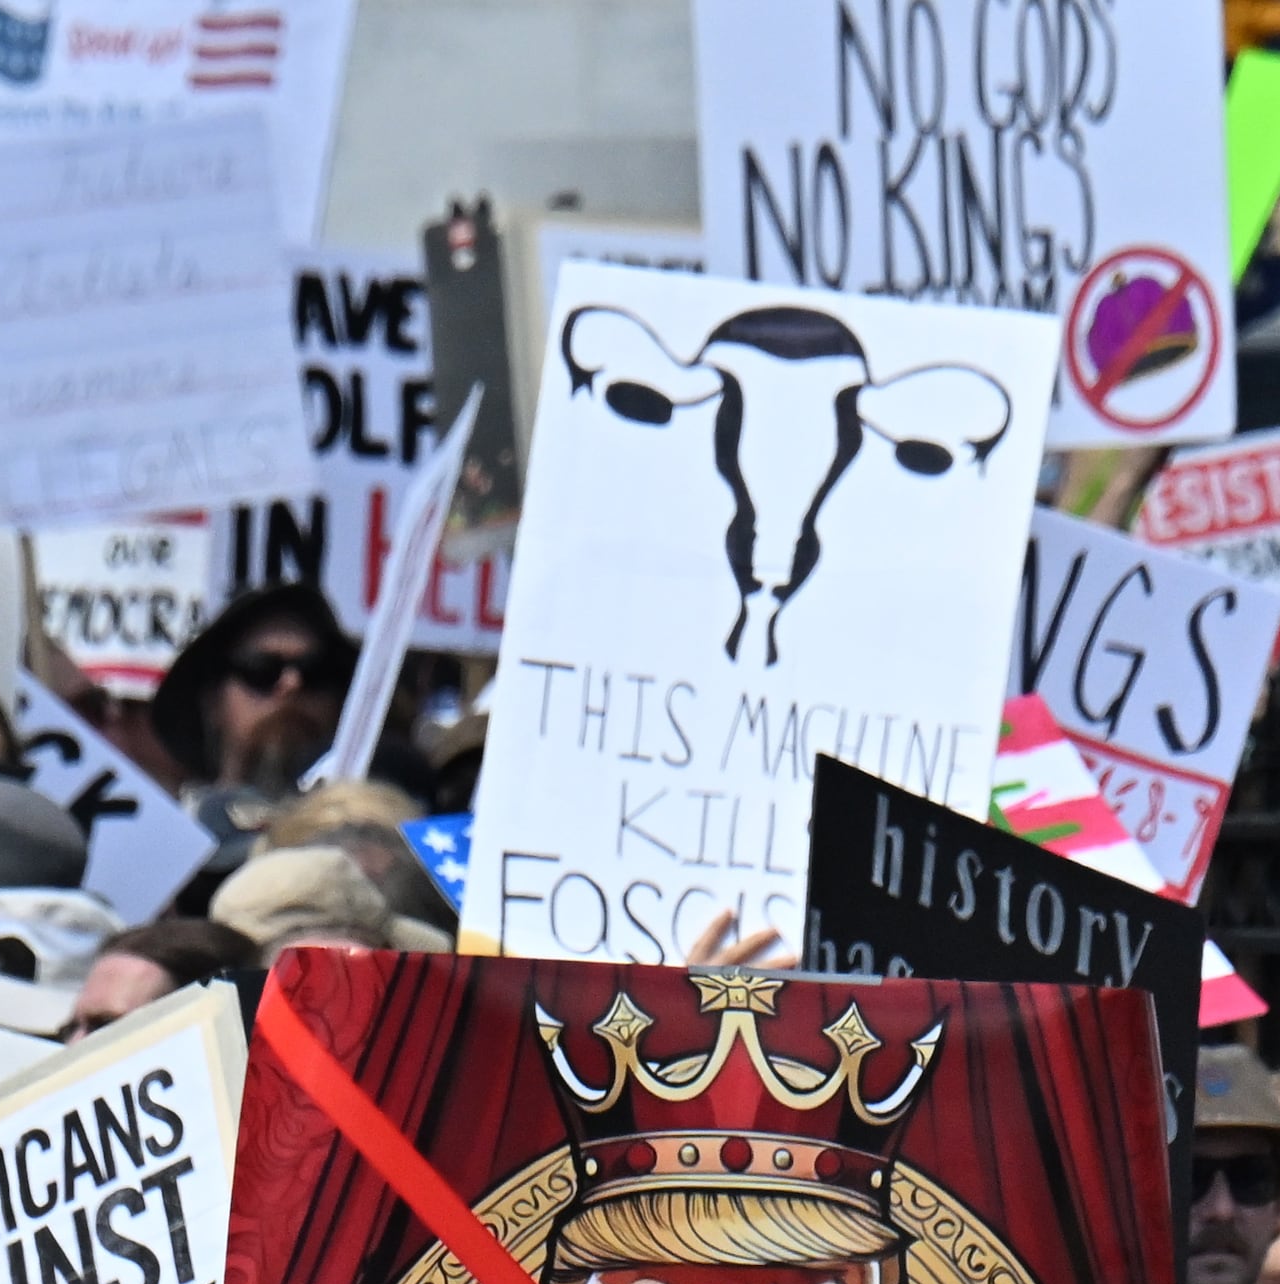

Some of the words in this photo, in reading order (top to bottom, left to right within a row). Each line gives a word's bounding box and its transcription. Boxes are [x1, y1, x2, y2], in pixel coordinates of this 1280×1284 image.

[741, 140, 851, 290] NO
[879, 124, 1096, 293] KINGS
[519, 656, 698, 768] THIS
[872, 793, 1155, 988] history
